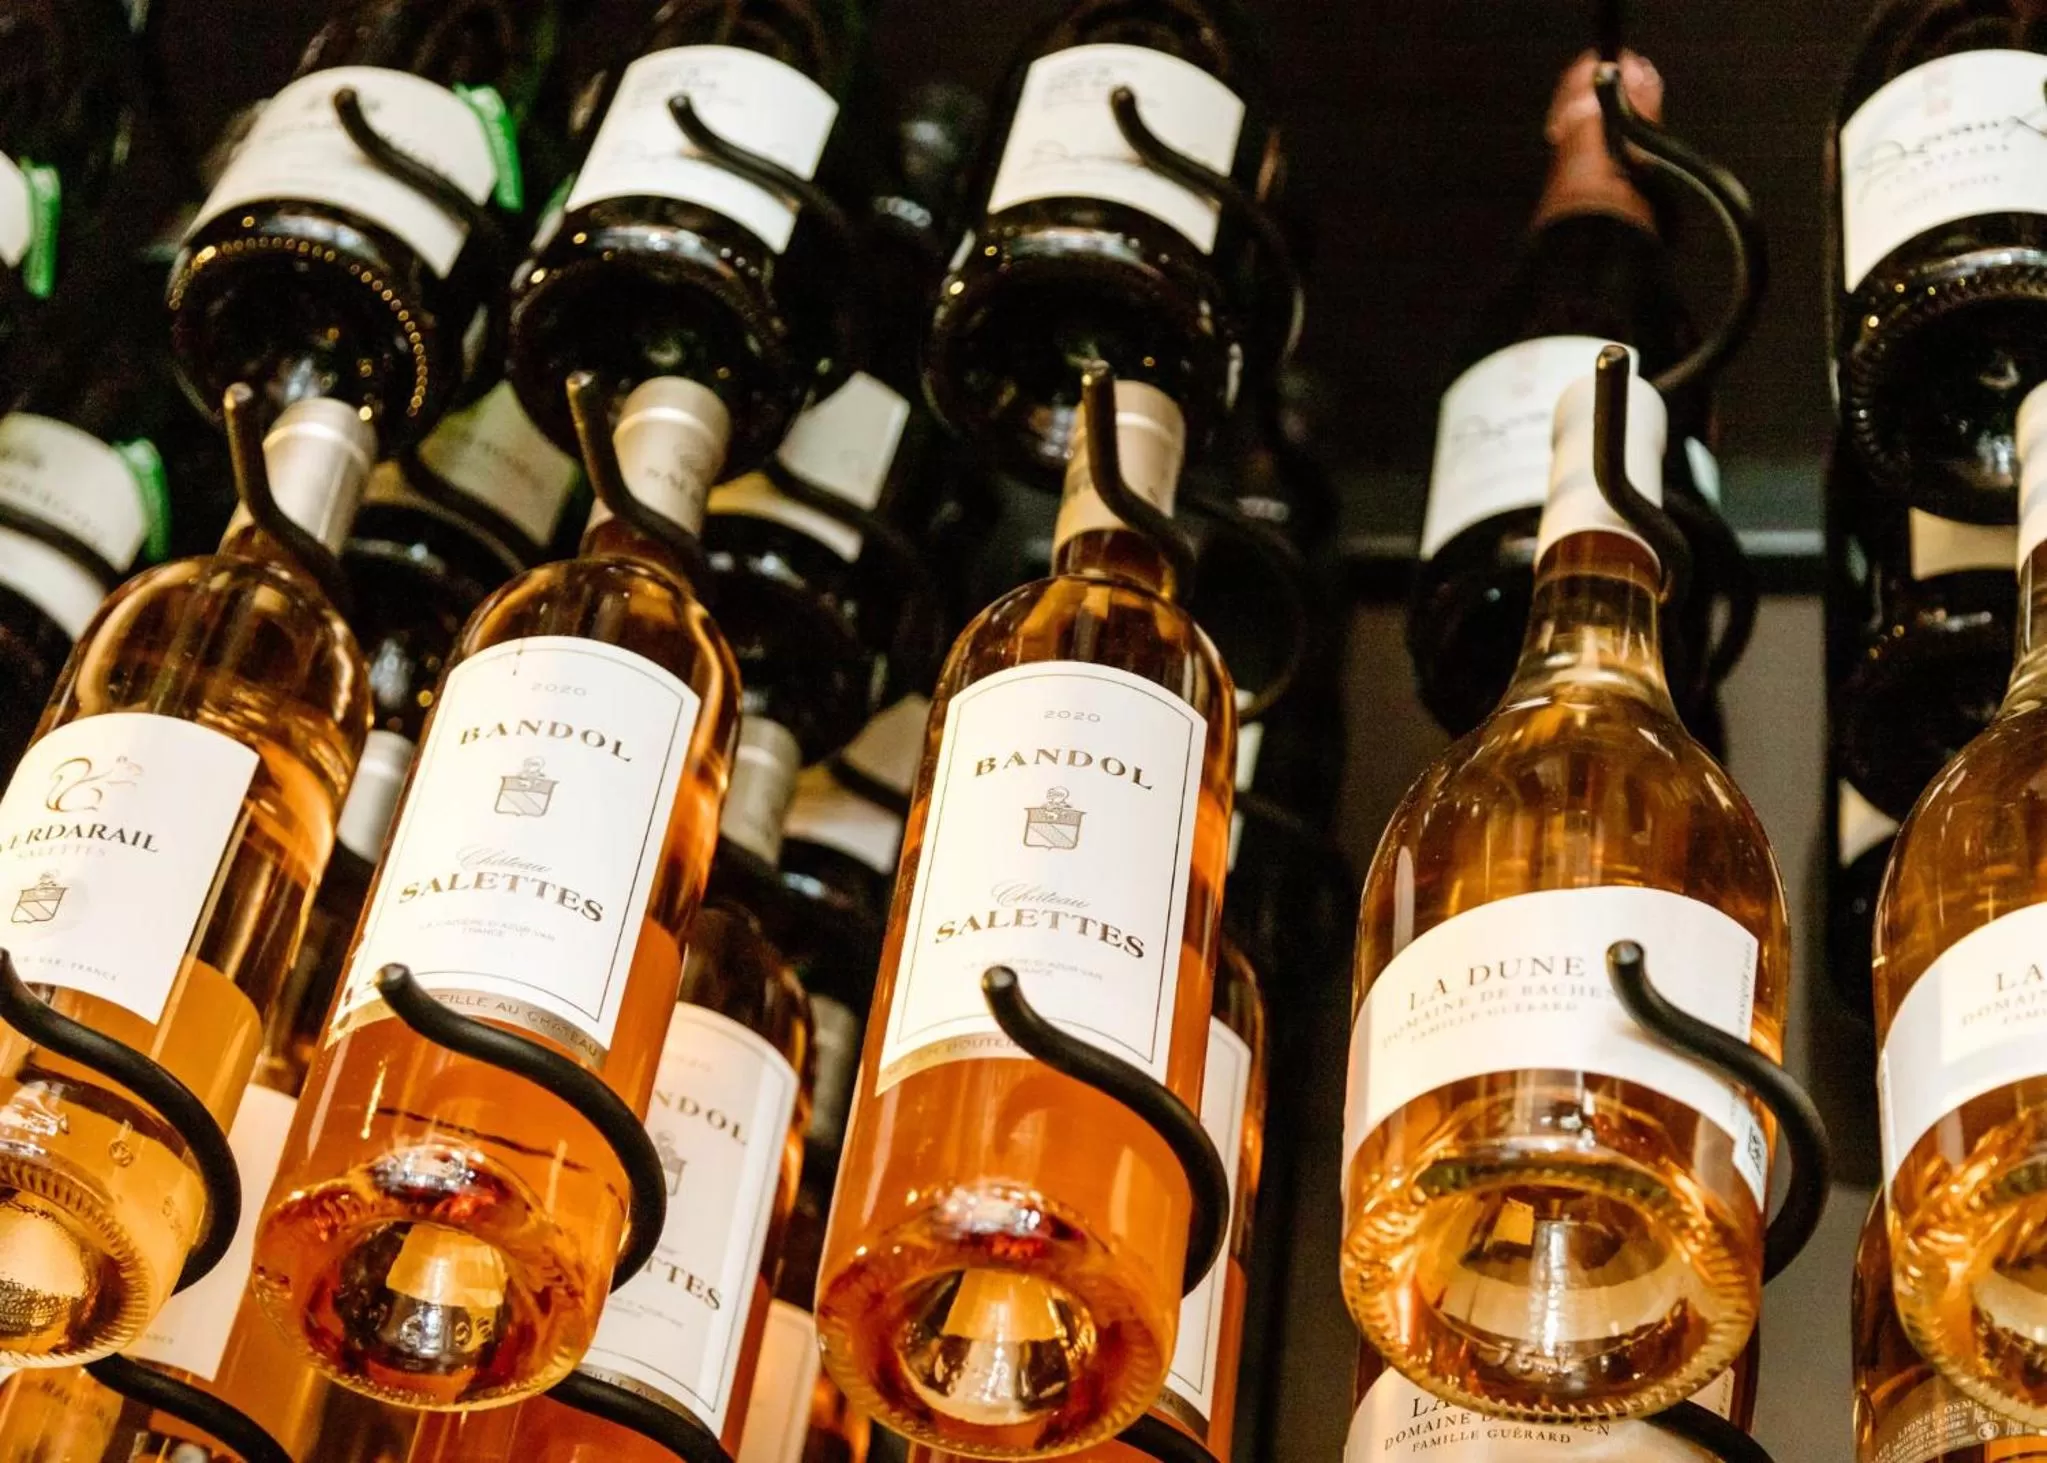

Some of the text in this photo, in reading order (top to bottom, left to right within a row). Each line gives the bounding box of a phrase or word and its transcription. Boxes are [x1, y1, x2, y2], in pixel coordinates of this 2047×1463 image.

[531, 681, 588, 698] 2020
[1043, 710, 1101, 723] 2020
[459, 719, 632, 763] BANDOL
[974, 748, 1153, 790] BANDOL
[398, 871, 604, 923] SALETTES
[934, 908, 1146, 959] SALETTES
[1409, 956, 1586, 1011] LA DUNE
[1479, 986, 1509, 1003] DE
[1995, 963, 2044, 993] LA
[495, 1000, 520, 1015] AU
[653, 1089, 749, 1147] NDOL
[1384, 1411, 1472, 1451] DOMAINE
[1411, 1430, 1480, 1452] FAMILLE
[1486, 1425, 1572, 1445] GUÉRARD
